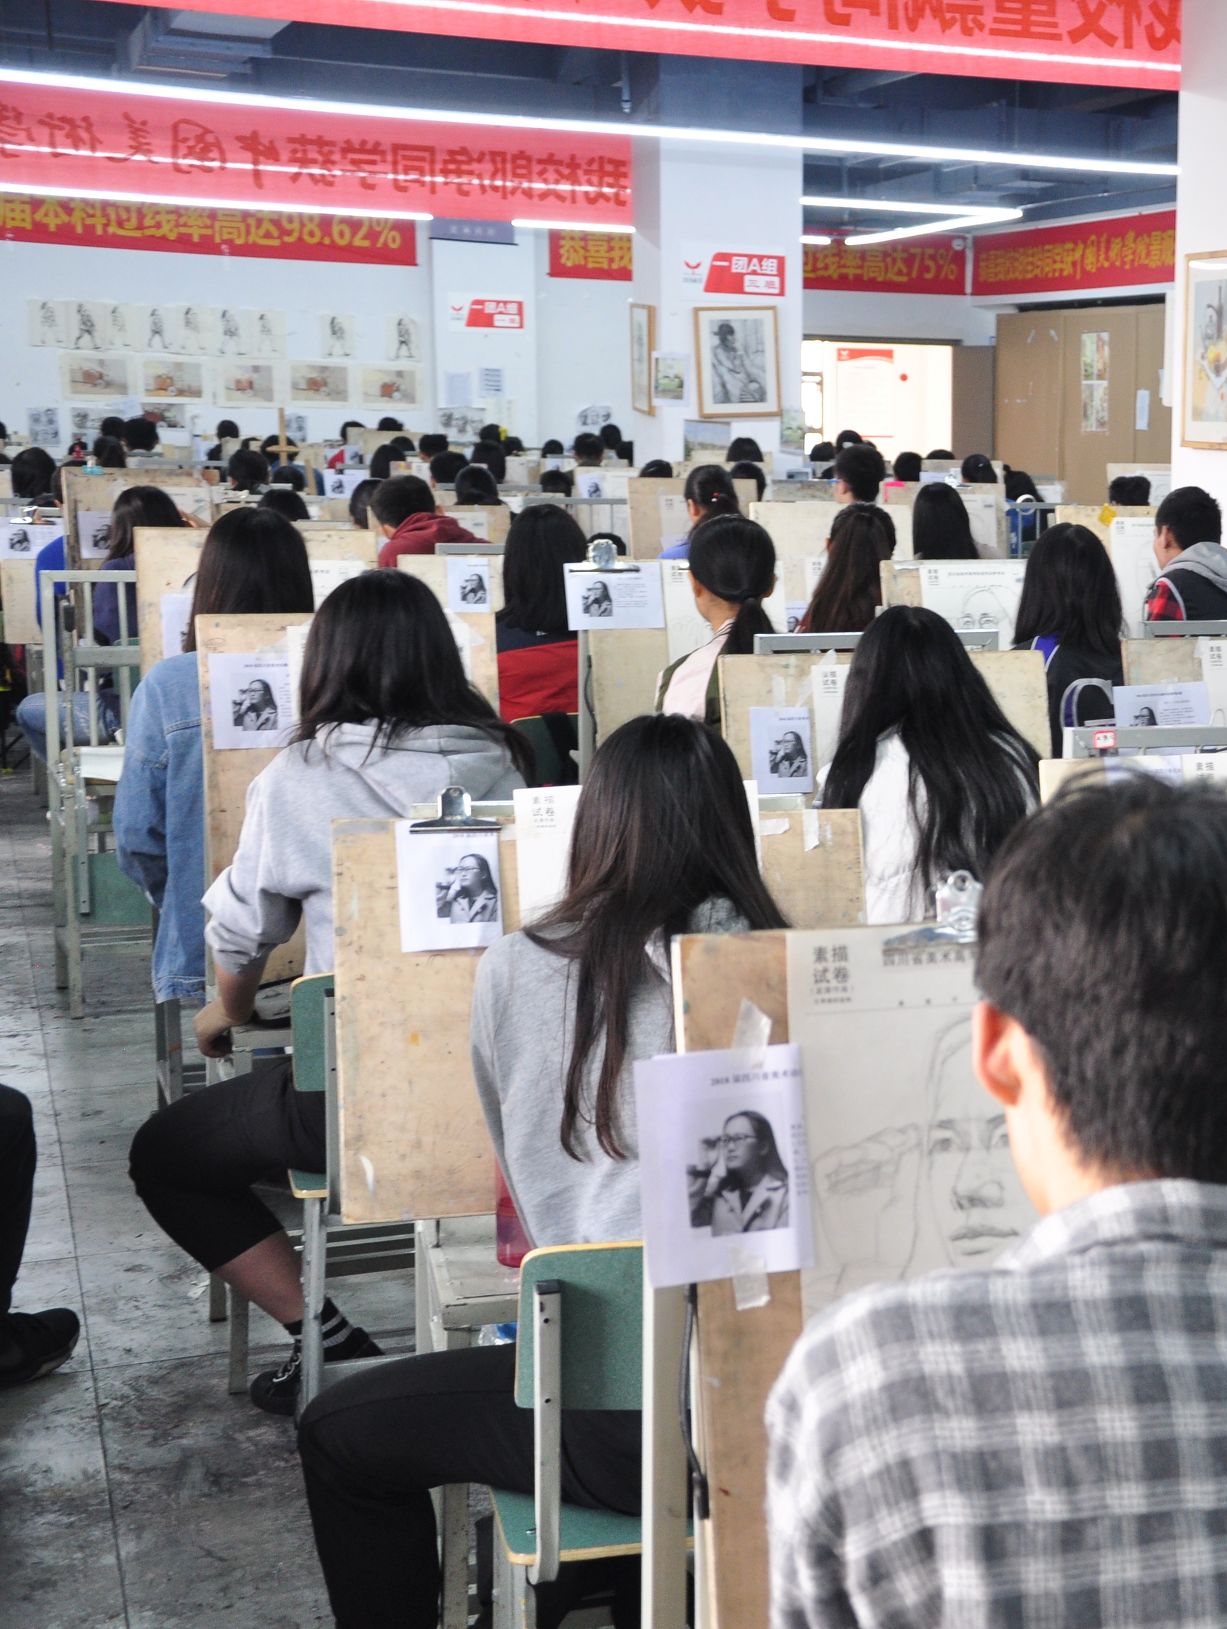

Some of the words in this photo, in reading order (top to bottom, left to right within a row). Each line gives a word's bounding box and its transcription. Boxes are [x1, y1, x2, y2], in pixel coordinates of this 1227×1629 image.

[712, 256, 777, 274] 一团A组
[813, 946, 848, 963] 素描
[813, 967, 849, 984] 试卷
